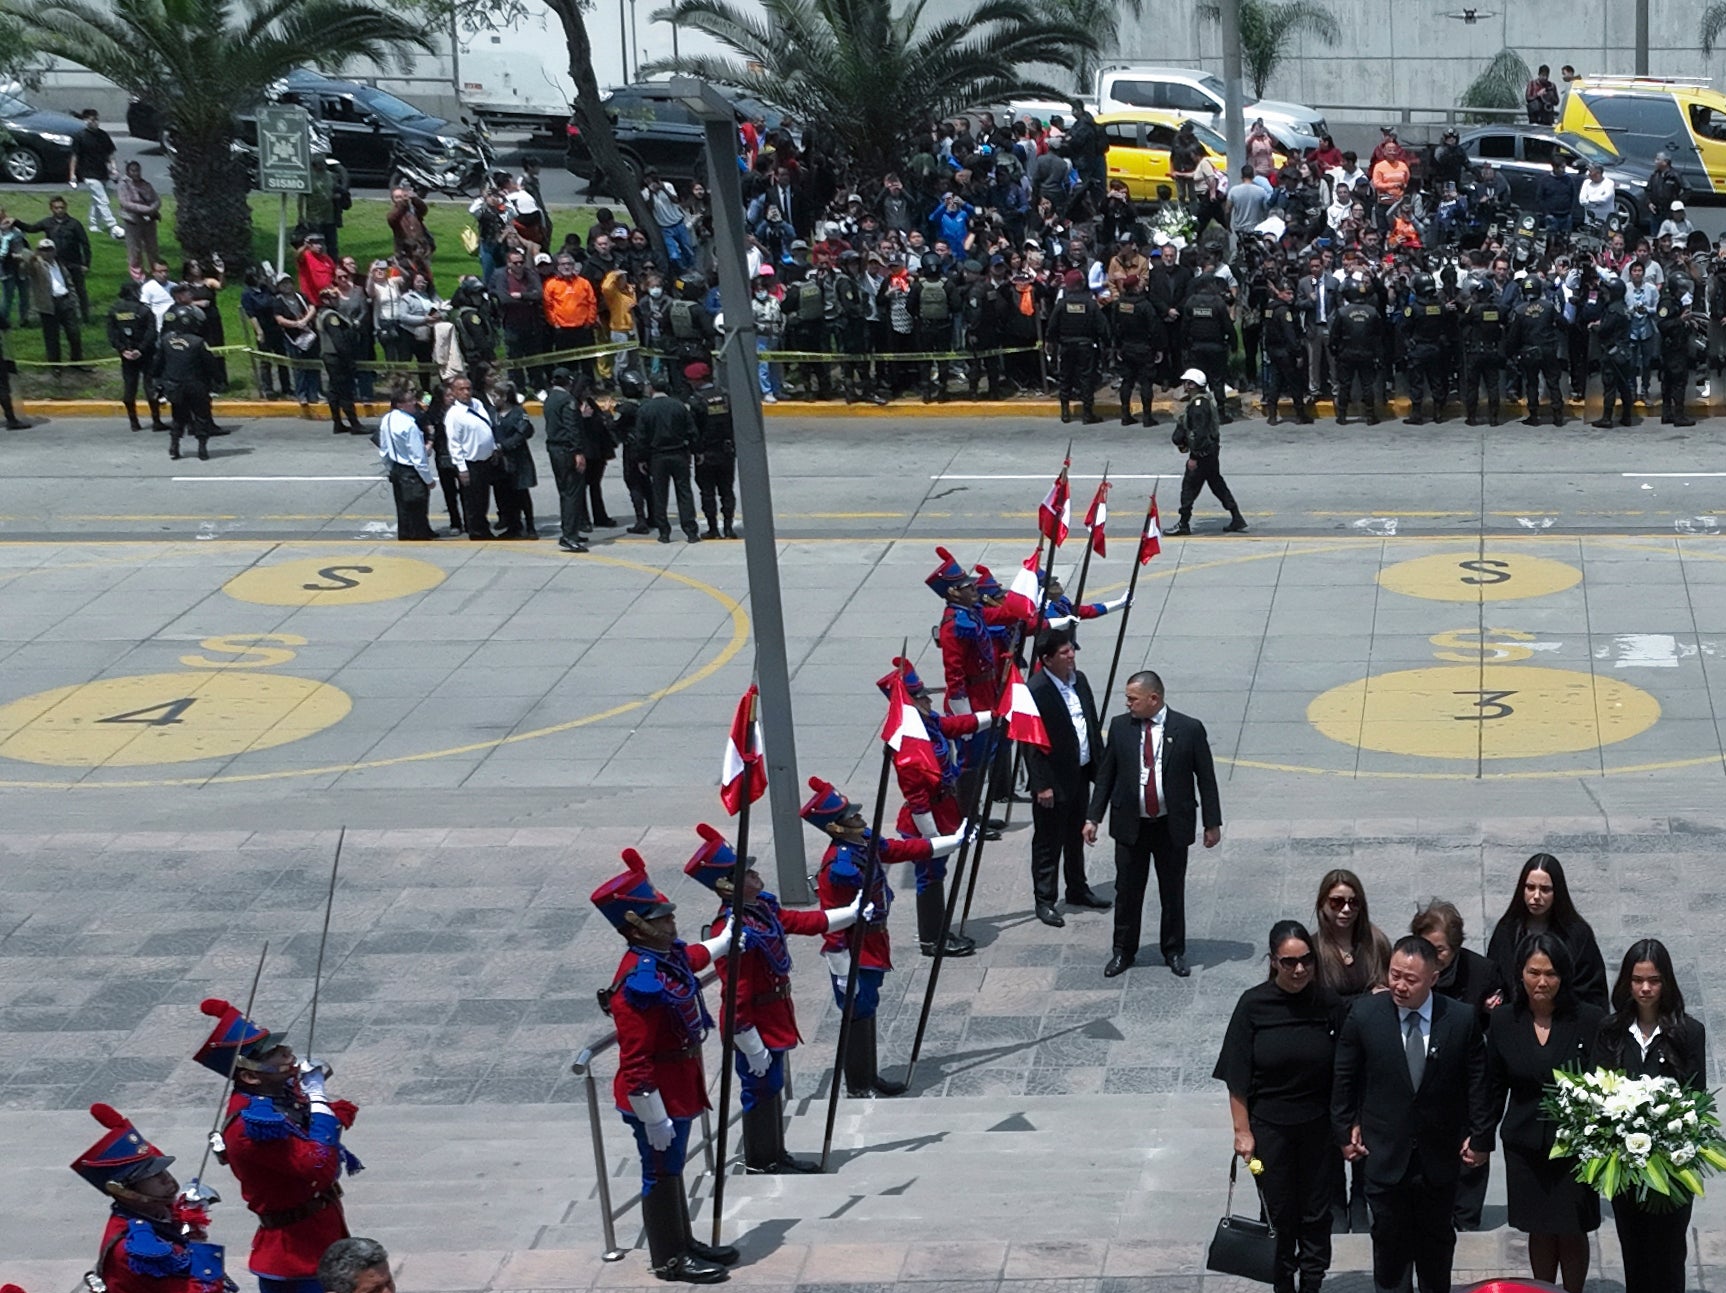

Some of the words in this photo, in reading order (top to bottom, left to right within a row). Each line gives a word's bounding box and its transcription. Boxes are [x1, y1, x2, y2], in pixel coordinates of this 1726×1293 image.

[268, 178, 305, 189] SISMO
[303, 566, 373, 591] S
[1459, 560, 1511, 585] S
[179, 633, 309, 668] S
[1428, 627, 1537, 663] S
[96, 697, 198, 726] 4
[1453, 690, 1519, 721] 3
